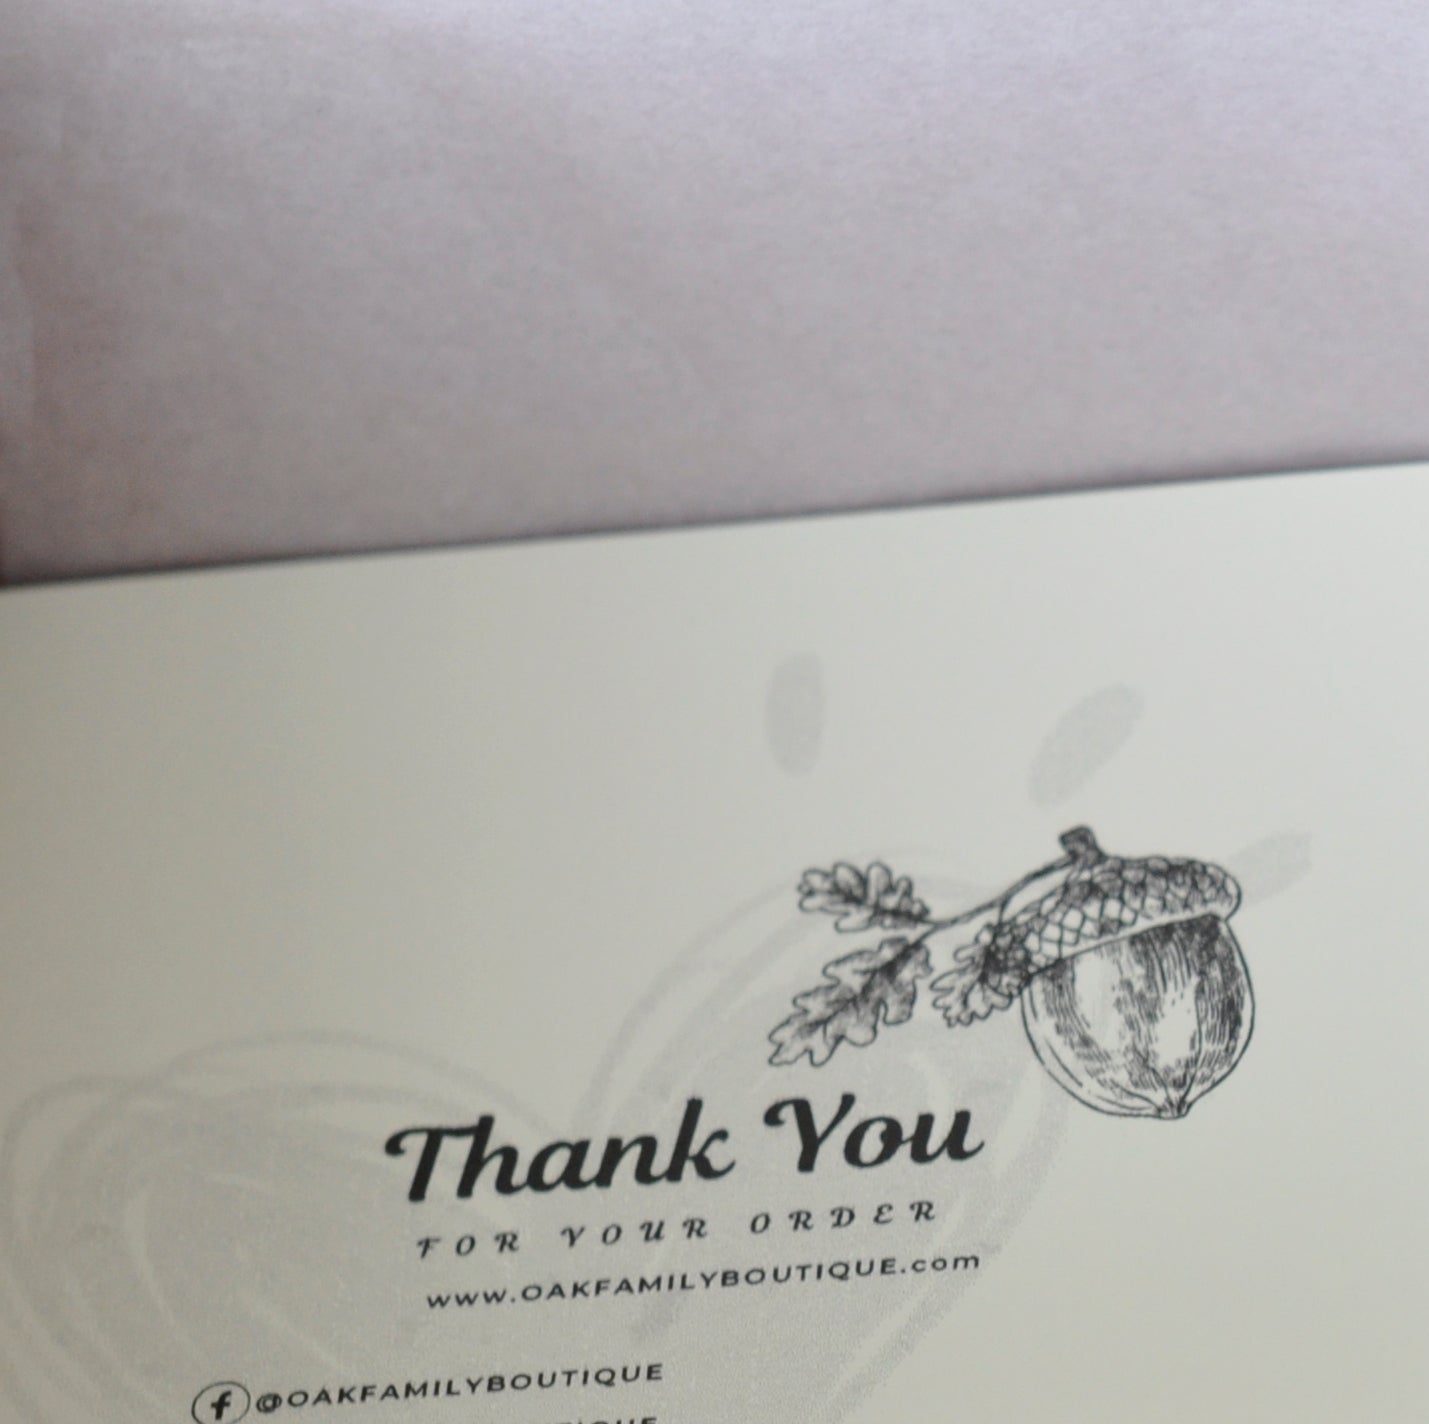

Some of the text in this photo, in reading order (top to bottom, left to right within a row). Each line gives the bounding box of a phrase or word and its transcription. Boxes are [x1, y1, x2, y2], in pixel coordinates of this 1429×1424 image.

[383, 1091, 986, 1205] Thank You
[415, 1200, 936, 1261] FOR YOUR ORDER
[426, 1254, 980, 1310] www.OAKFAMILYBOUTIQUE.com
[255, 1362, 664, 1415] @OAKFAMILYBOUTIQUE
